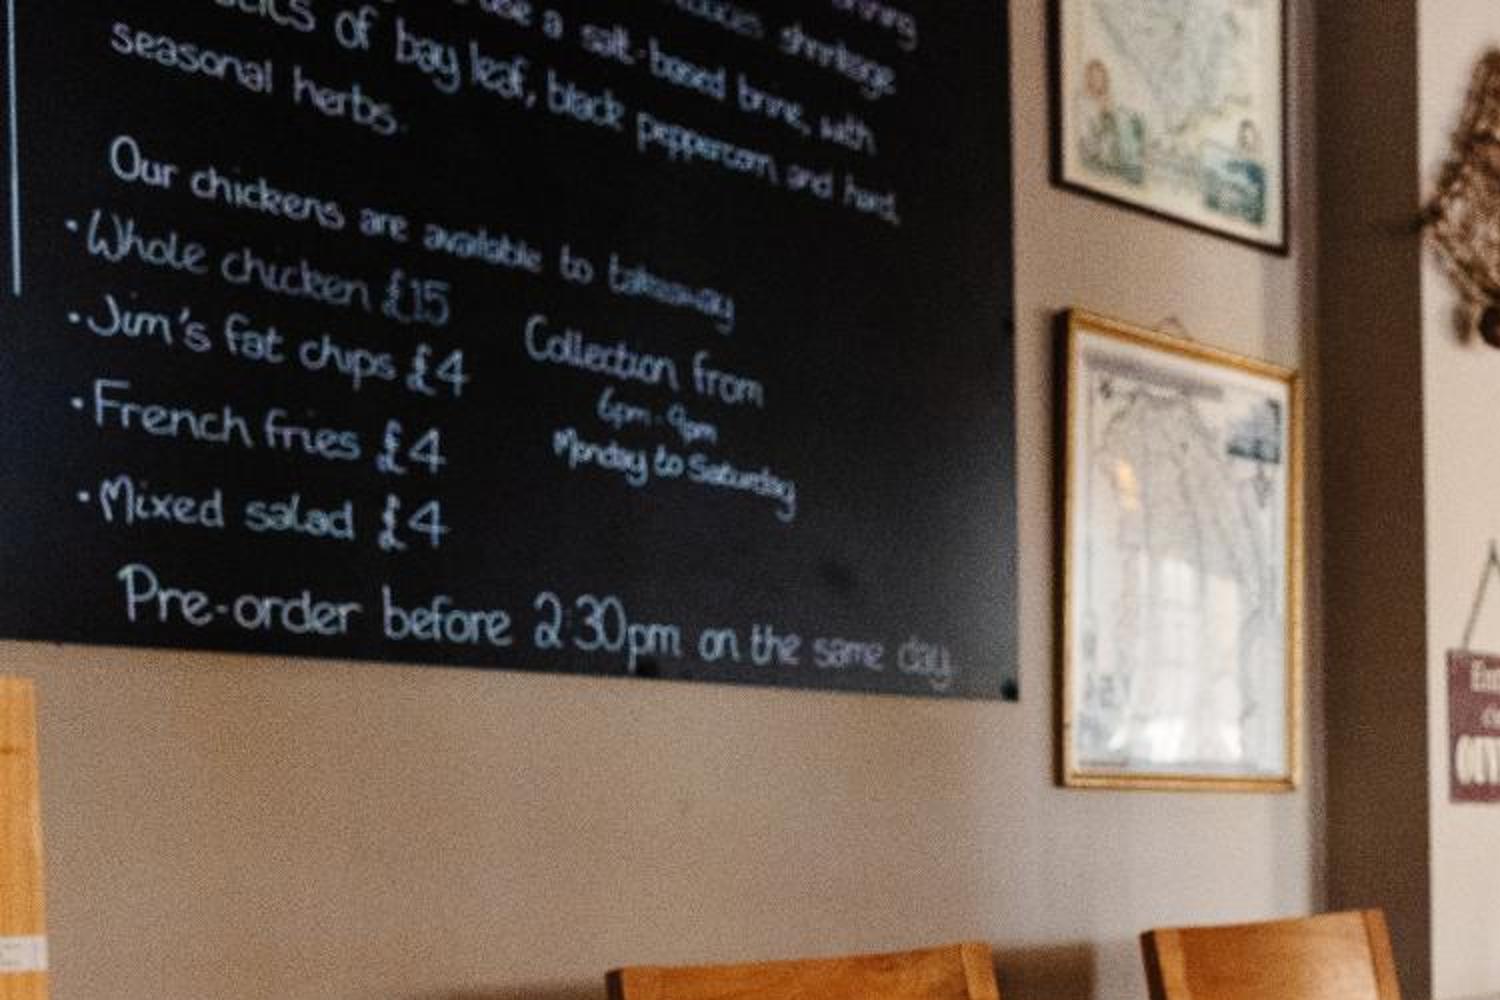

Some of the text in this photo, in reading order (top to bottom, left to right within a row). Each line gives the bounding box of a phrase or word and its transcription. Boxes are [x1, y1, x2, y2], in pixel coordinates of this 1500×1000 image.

[110, 22, 273, 94] seasonal
[335, 5, 379, 50] of
[396, 17, 461, 94] bay
[469, 41, 537, 107] leaf,
[547, 68, 626, 131] black
[636, 112, 778, 187] peppercorn
[110, 135, 178, 188] Our
[190, 166, 346, 230] chickens
[359, 207, 408, 242] are
[423, 222, 543, 273] available
[559, 245, 594, 285] to
[87, 209, 450, 326] Whole chicken £15
[87, 294, 470, 397] Jim's fat chips £4
[525, 314, 765, 409] Collection from
[93, 378, 446, 474] French fries £4
[598, 386, 652, 430] 6pm
[667, 403, 719, 446] 9pm
[99, 474, 450, 552] Mixed salad £4
[552, 427, 797, 523] Monday to Saturday
[117, 563, 363, 637] Pre-order
[382, 584, 513, 647] before
[698, 626, 742, 664] on
[750, 622, 801, 667] the
[813, 637, 886, 673] same
[896, 635, 956, 693] day
